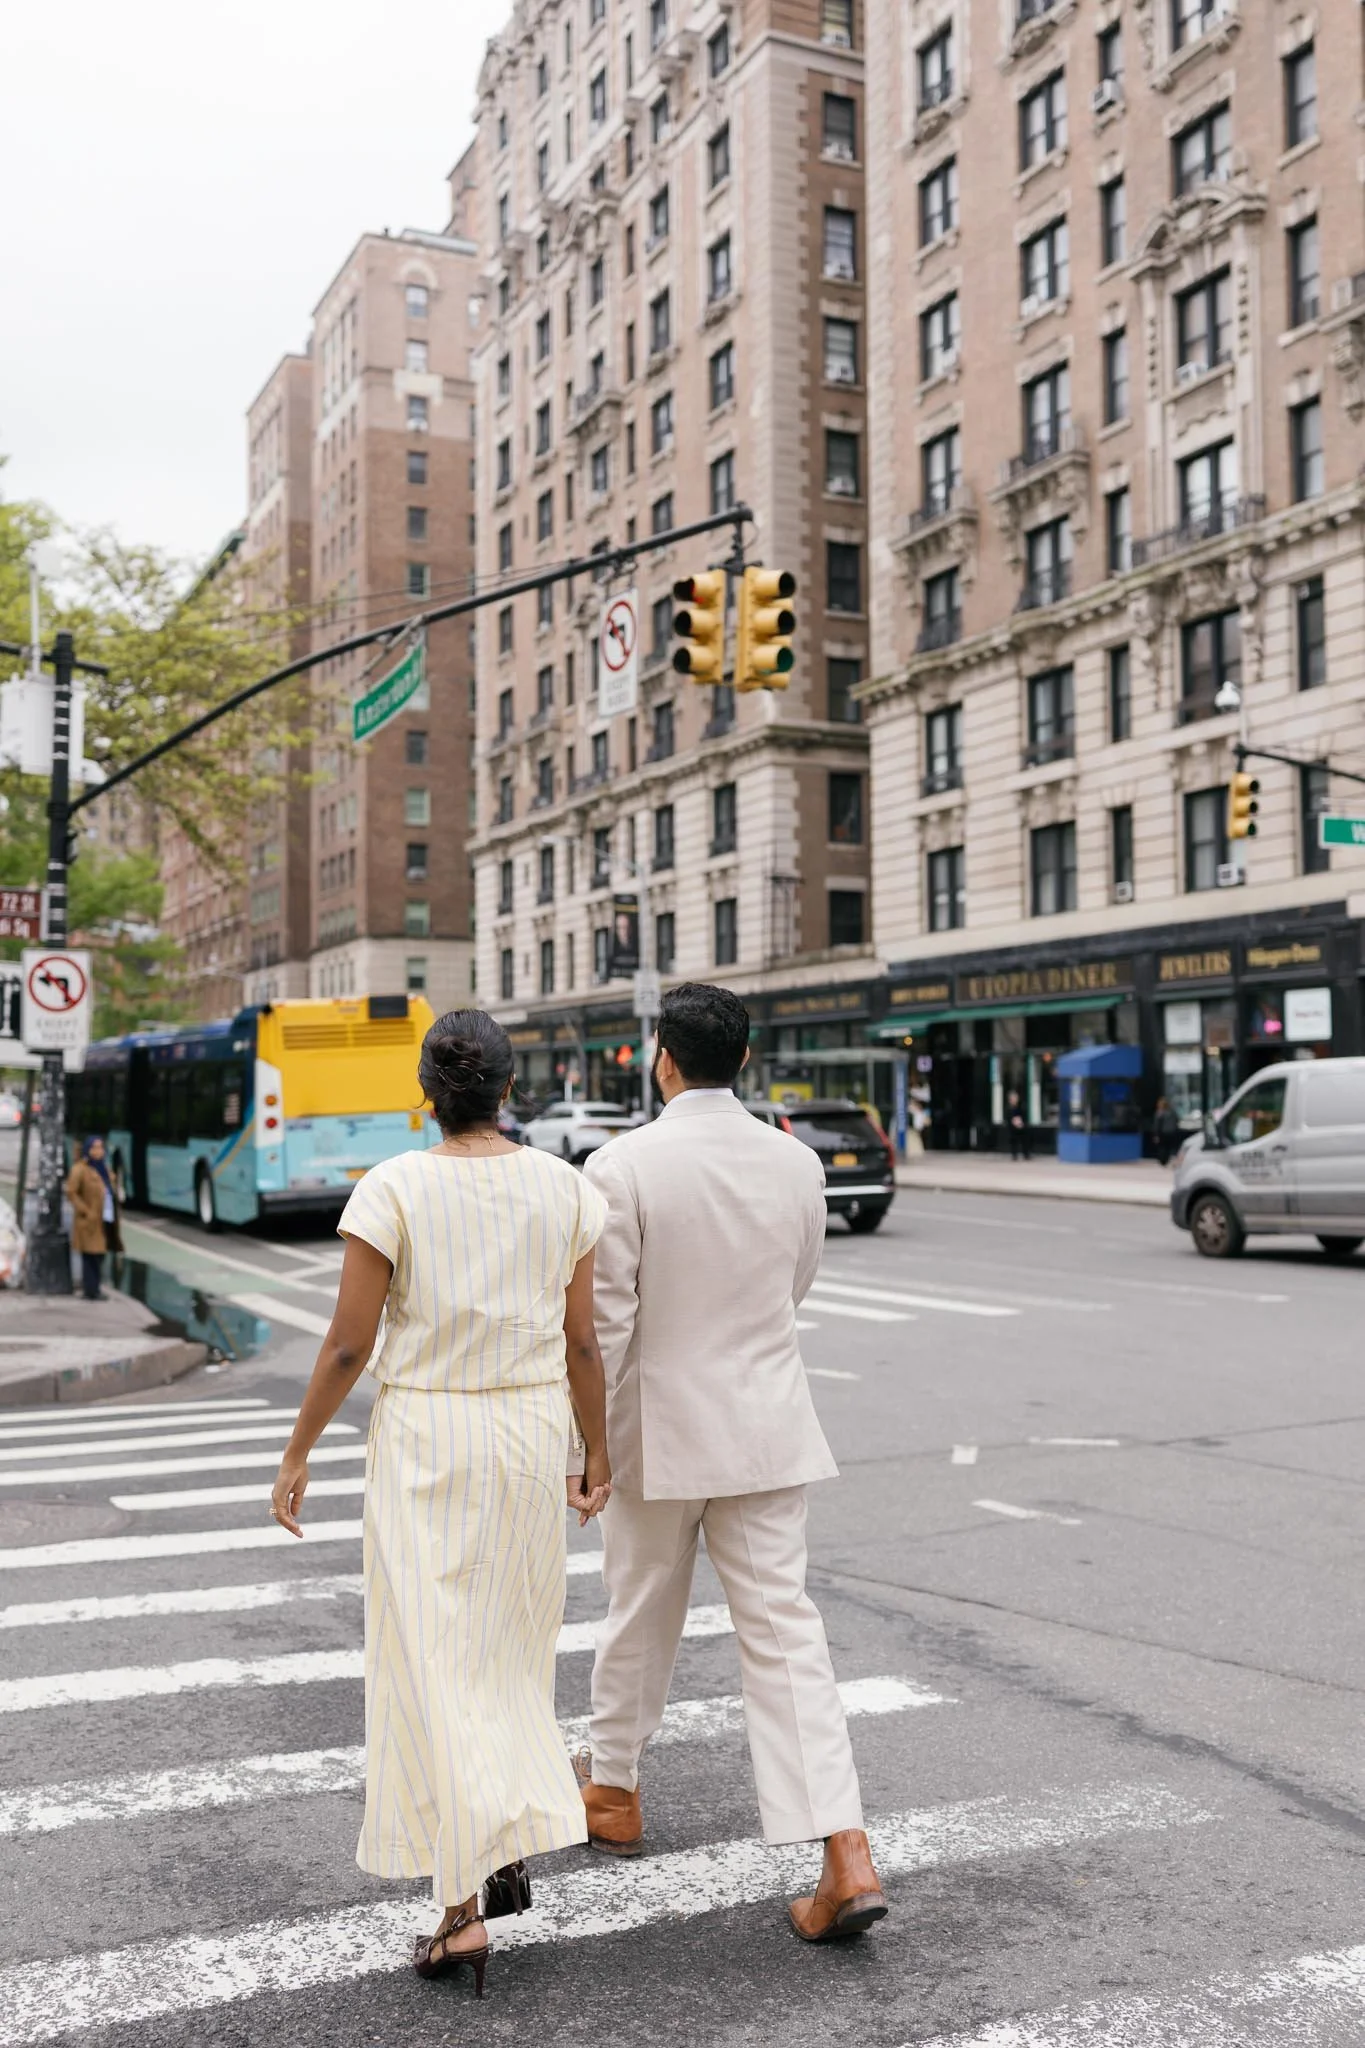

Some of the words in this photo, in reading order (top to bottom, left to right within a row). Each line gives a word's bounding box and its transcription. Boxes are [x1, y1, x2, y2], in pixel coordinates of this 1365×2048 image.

[969, 971, 1043, 999] UTOPIA
[1048, 963, 1118, 993] DINER
[1160, 951, 1231, 981] JEWELERS
